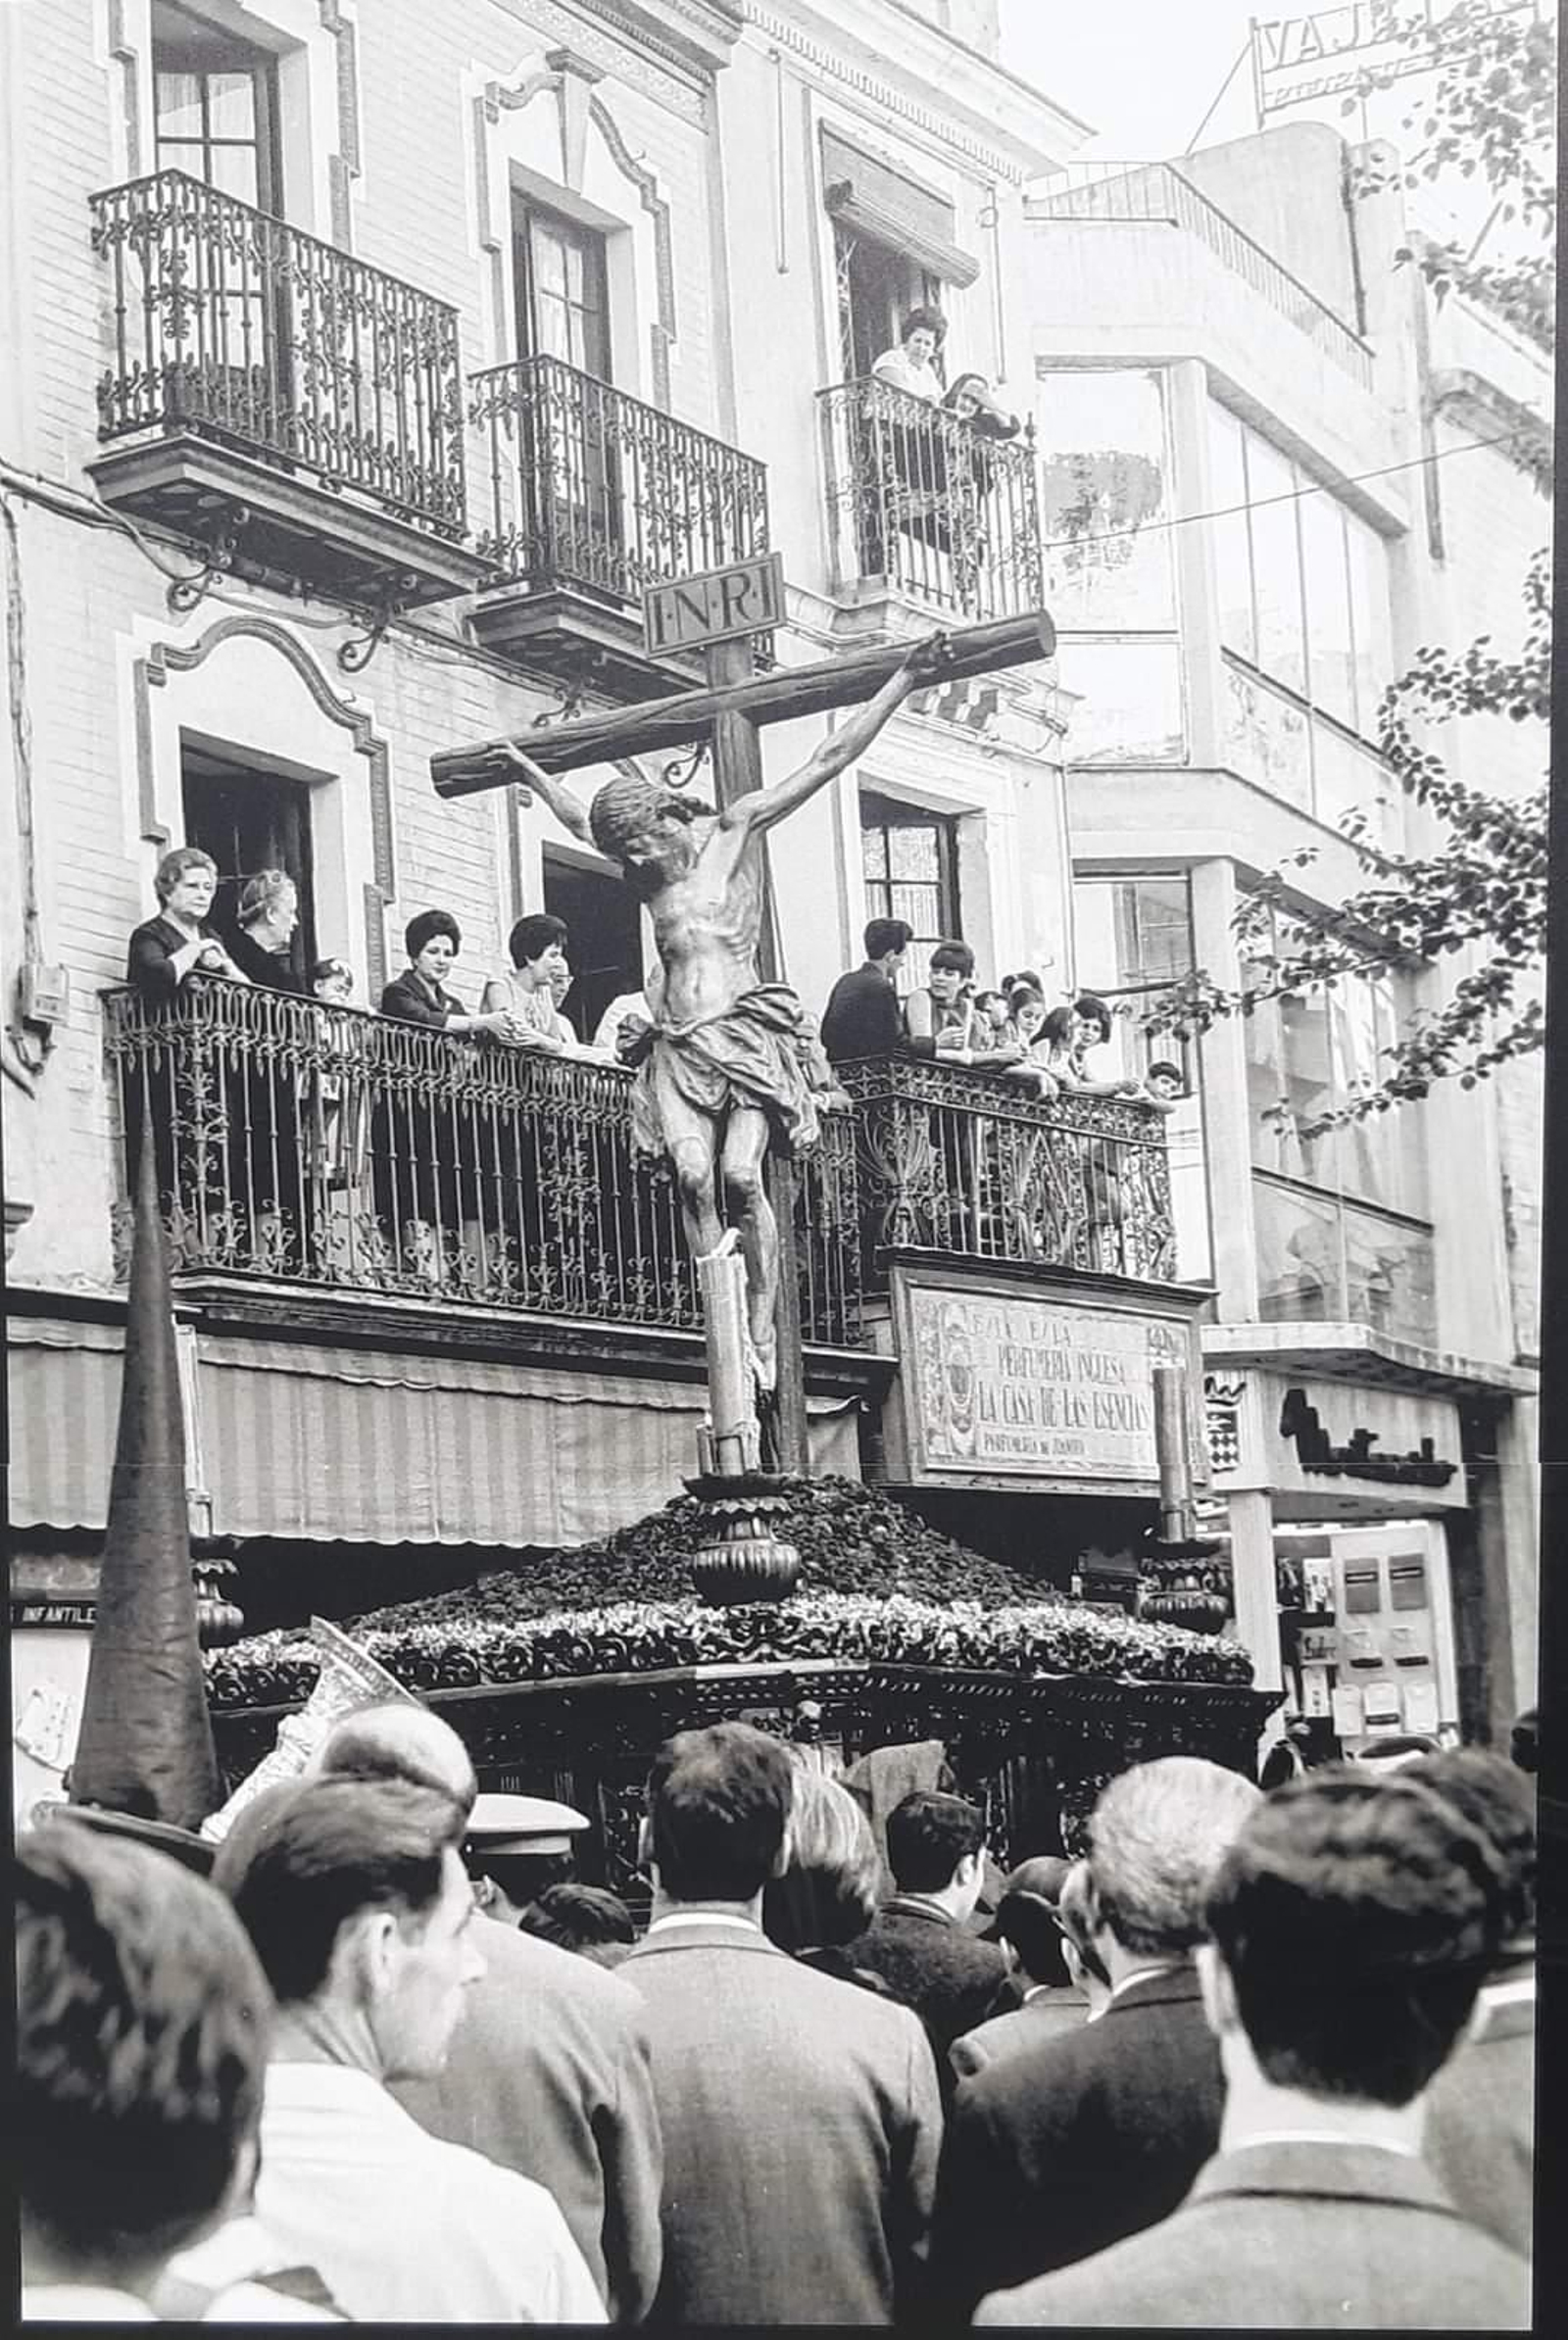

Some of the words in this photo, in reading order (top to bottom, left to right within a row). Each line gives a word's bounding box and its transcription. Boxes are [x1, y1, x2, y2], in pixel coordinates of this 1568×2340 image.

[977, 1381, 998, 1422] LA
[1003, 1384, 1035, 1425] CASA
[1062, 1388, 1090, 1428] LAS
[1093, 1390, 1152, 1431] ESENCIAS
